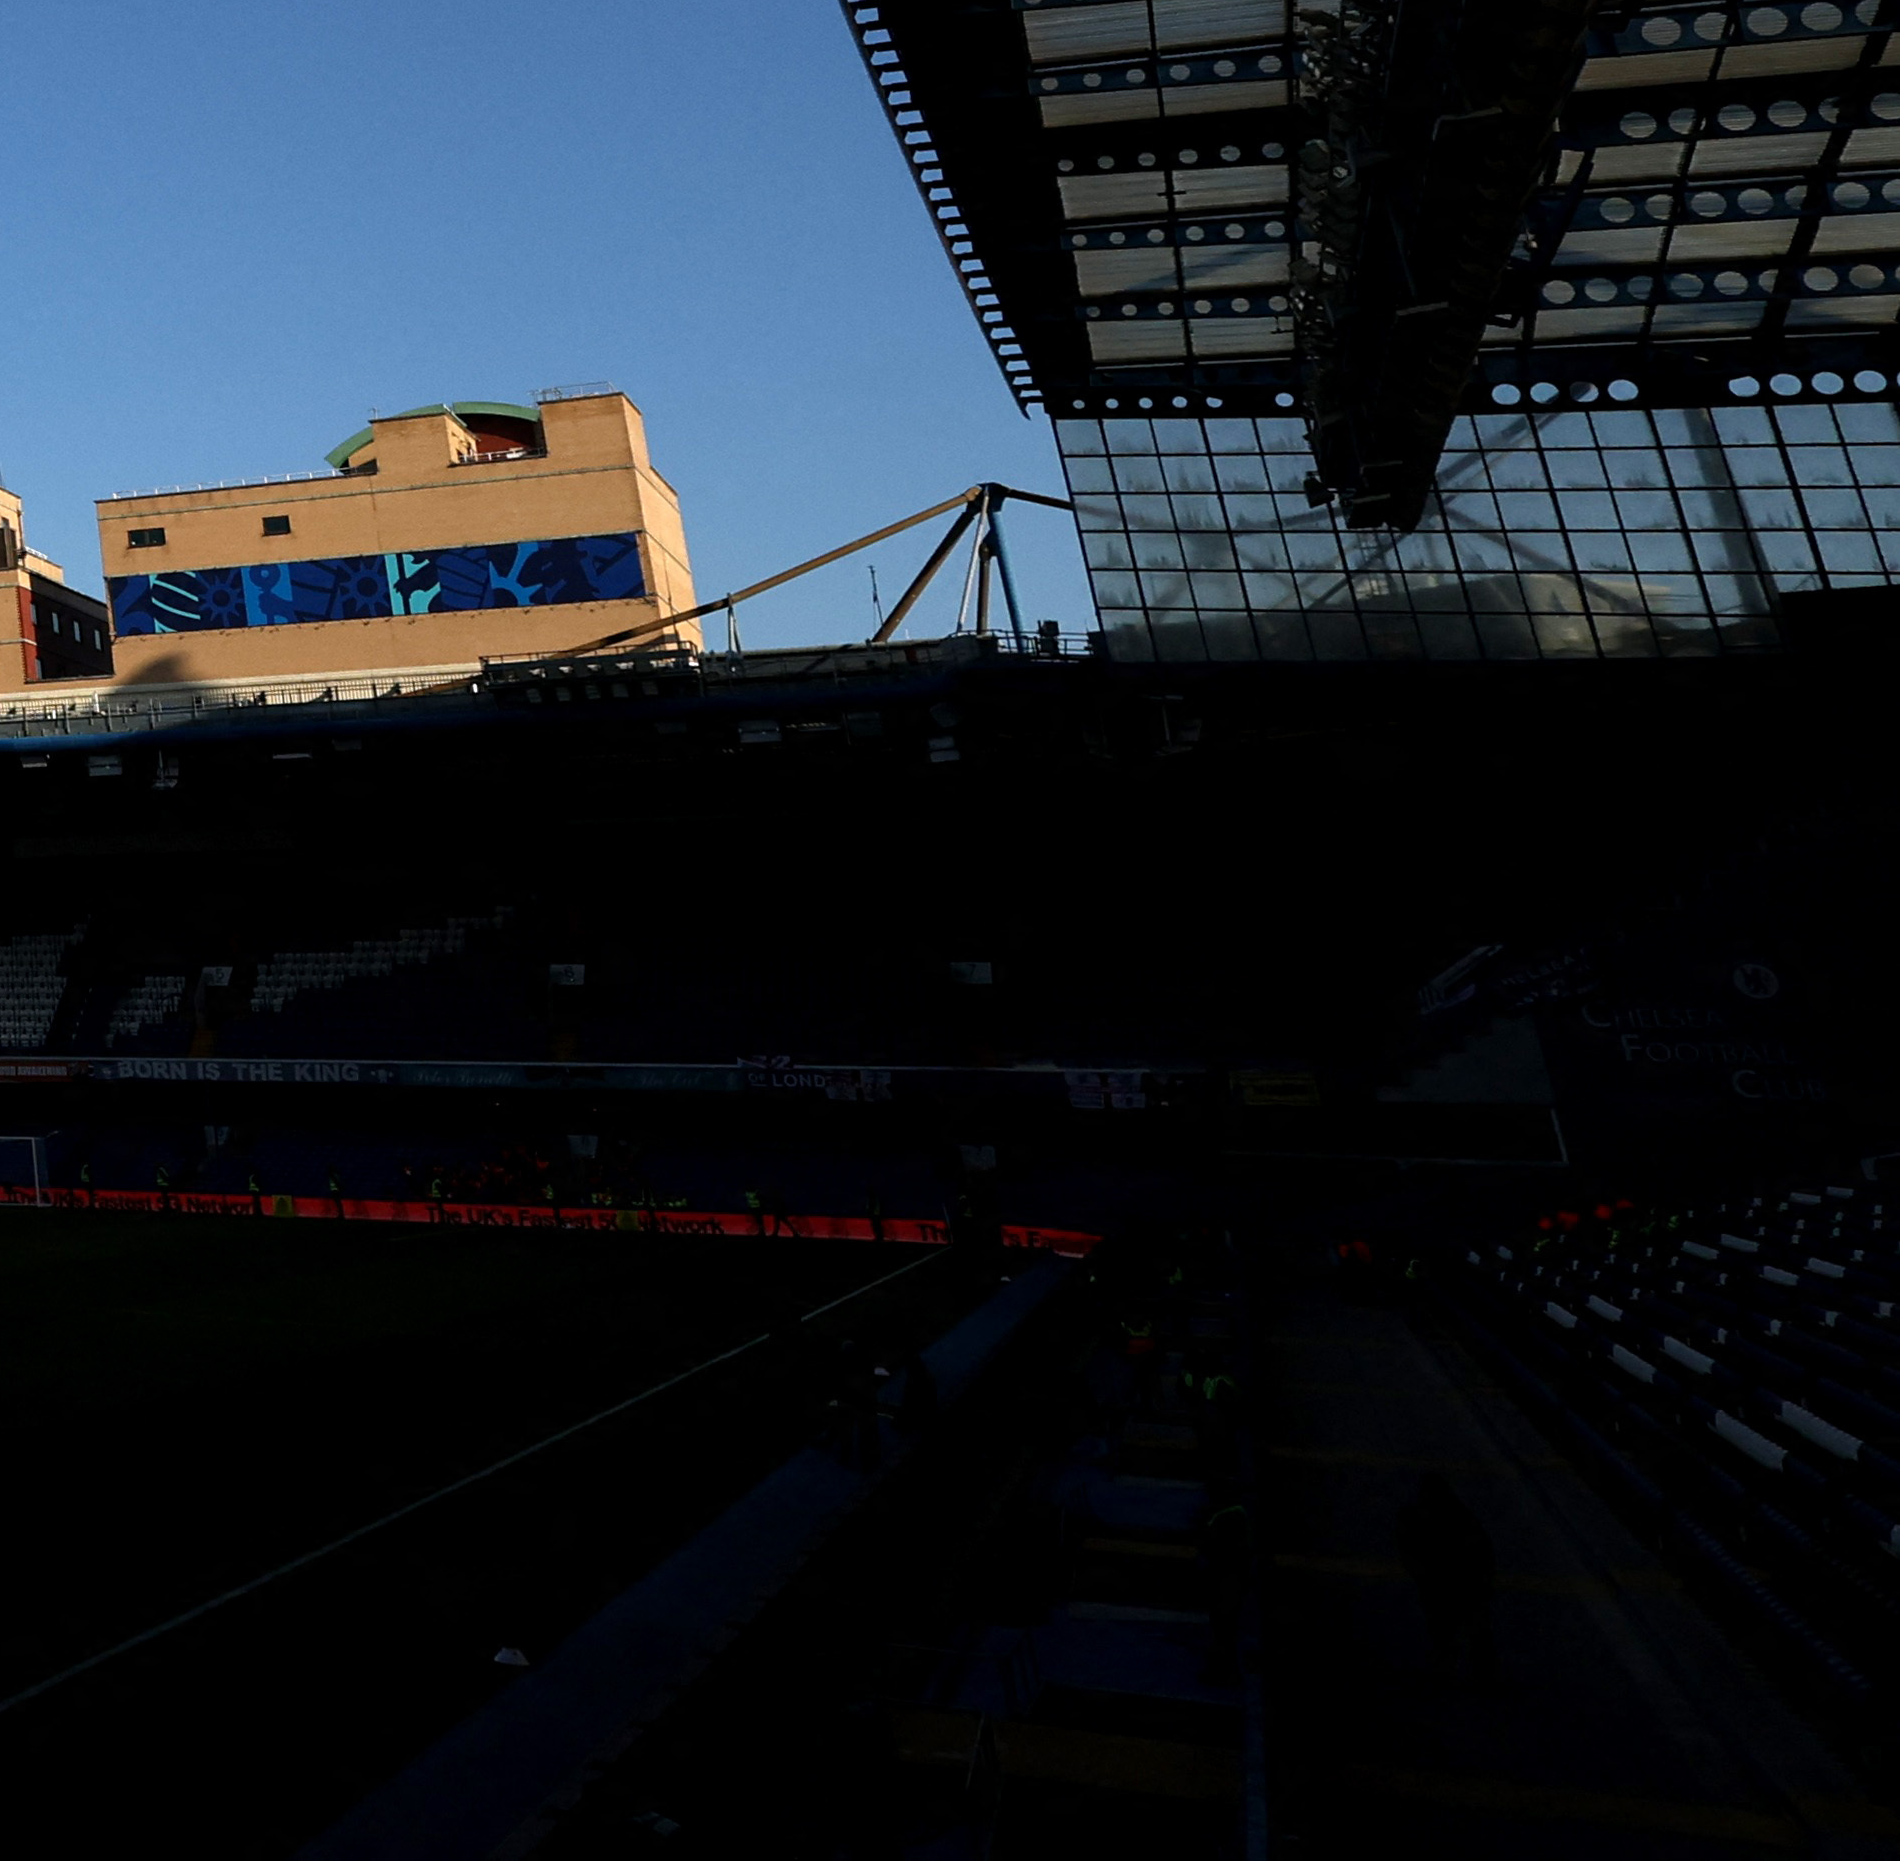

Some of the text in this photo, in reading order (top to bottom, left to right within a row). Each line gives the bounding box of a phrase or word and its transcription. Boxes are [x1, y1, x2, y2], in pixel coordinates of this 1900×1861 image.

[118, 1060, 359, 1082] BORN IS THE KING
[771, 1074, 826, 1088] LOND
[1731, 1070, 1827, 1100] CLUB
